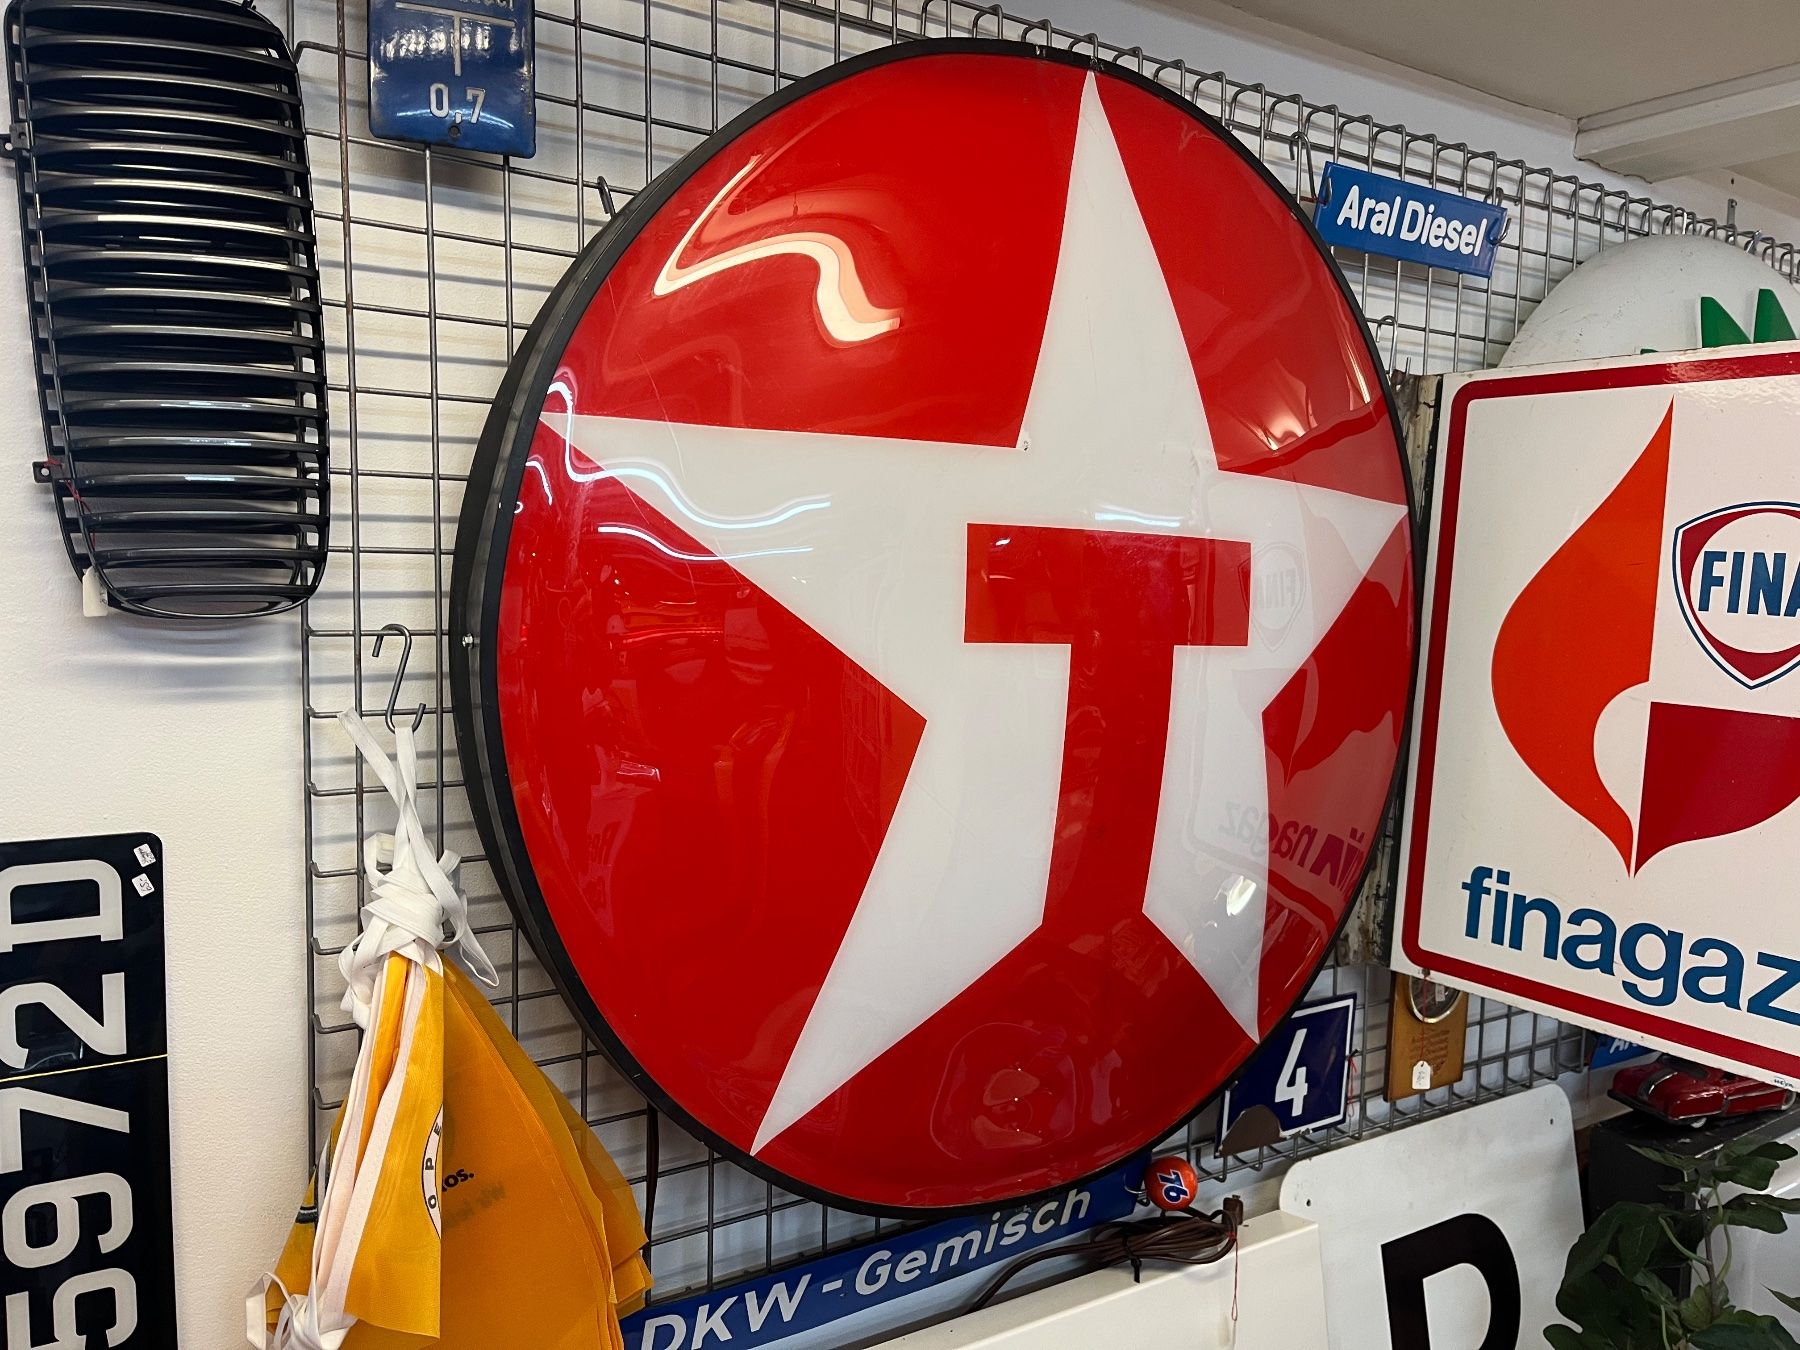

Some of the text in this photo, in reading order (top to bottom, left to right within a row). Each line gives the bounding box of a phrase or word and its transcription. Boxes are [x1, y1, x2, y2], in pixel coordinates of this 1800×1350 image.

[430, 83, 486, 124] 0,7
[1336, 184, 1488, 257] Aral Diesel
[963, 522, 1252, 925] T
[1461, 865, 1800, 1027] finagaz
[1274, 1028, 1308, 1117] 4
[442, 1168, 474, 1192] os.
[1157, 1169, 1190, 1204] 76
